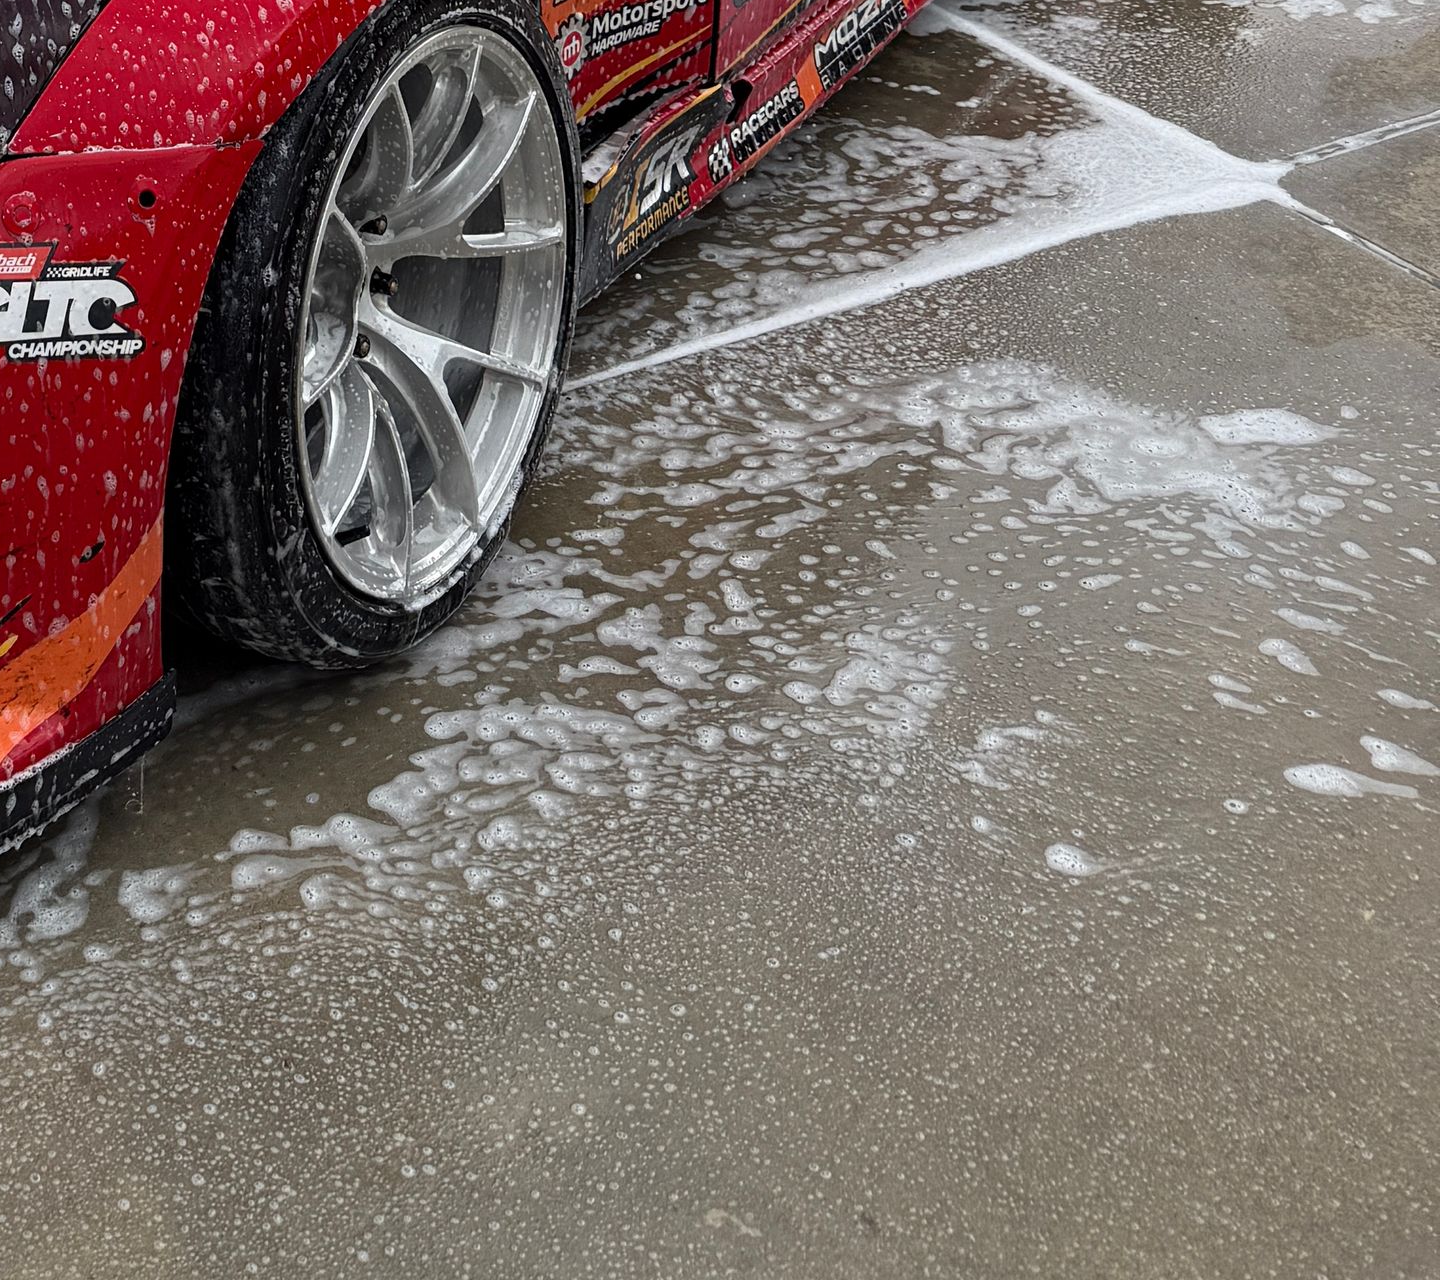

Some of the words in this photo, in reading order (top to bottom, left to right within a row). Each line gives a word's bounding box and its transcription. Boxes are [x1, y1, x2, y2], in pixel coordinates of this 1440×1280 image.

[591, 19, 660, 56] HARDWARE
[730, 79, 800, 147] RACECARS
[615, 184, 690, 263] PERFORMANCE
[61, 266, 113, 279] GRIDLIFE
[8, 339, 144, 360] CHAMPIONSHIP
